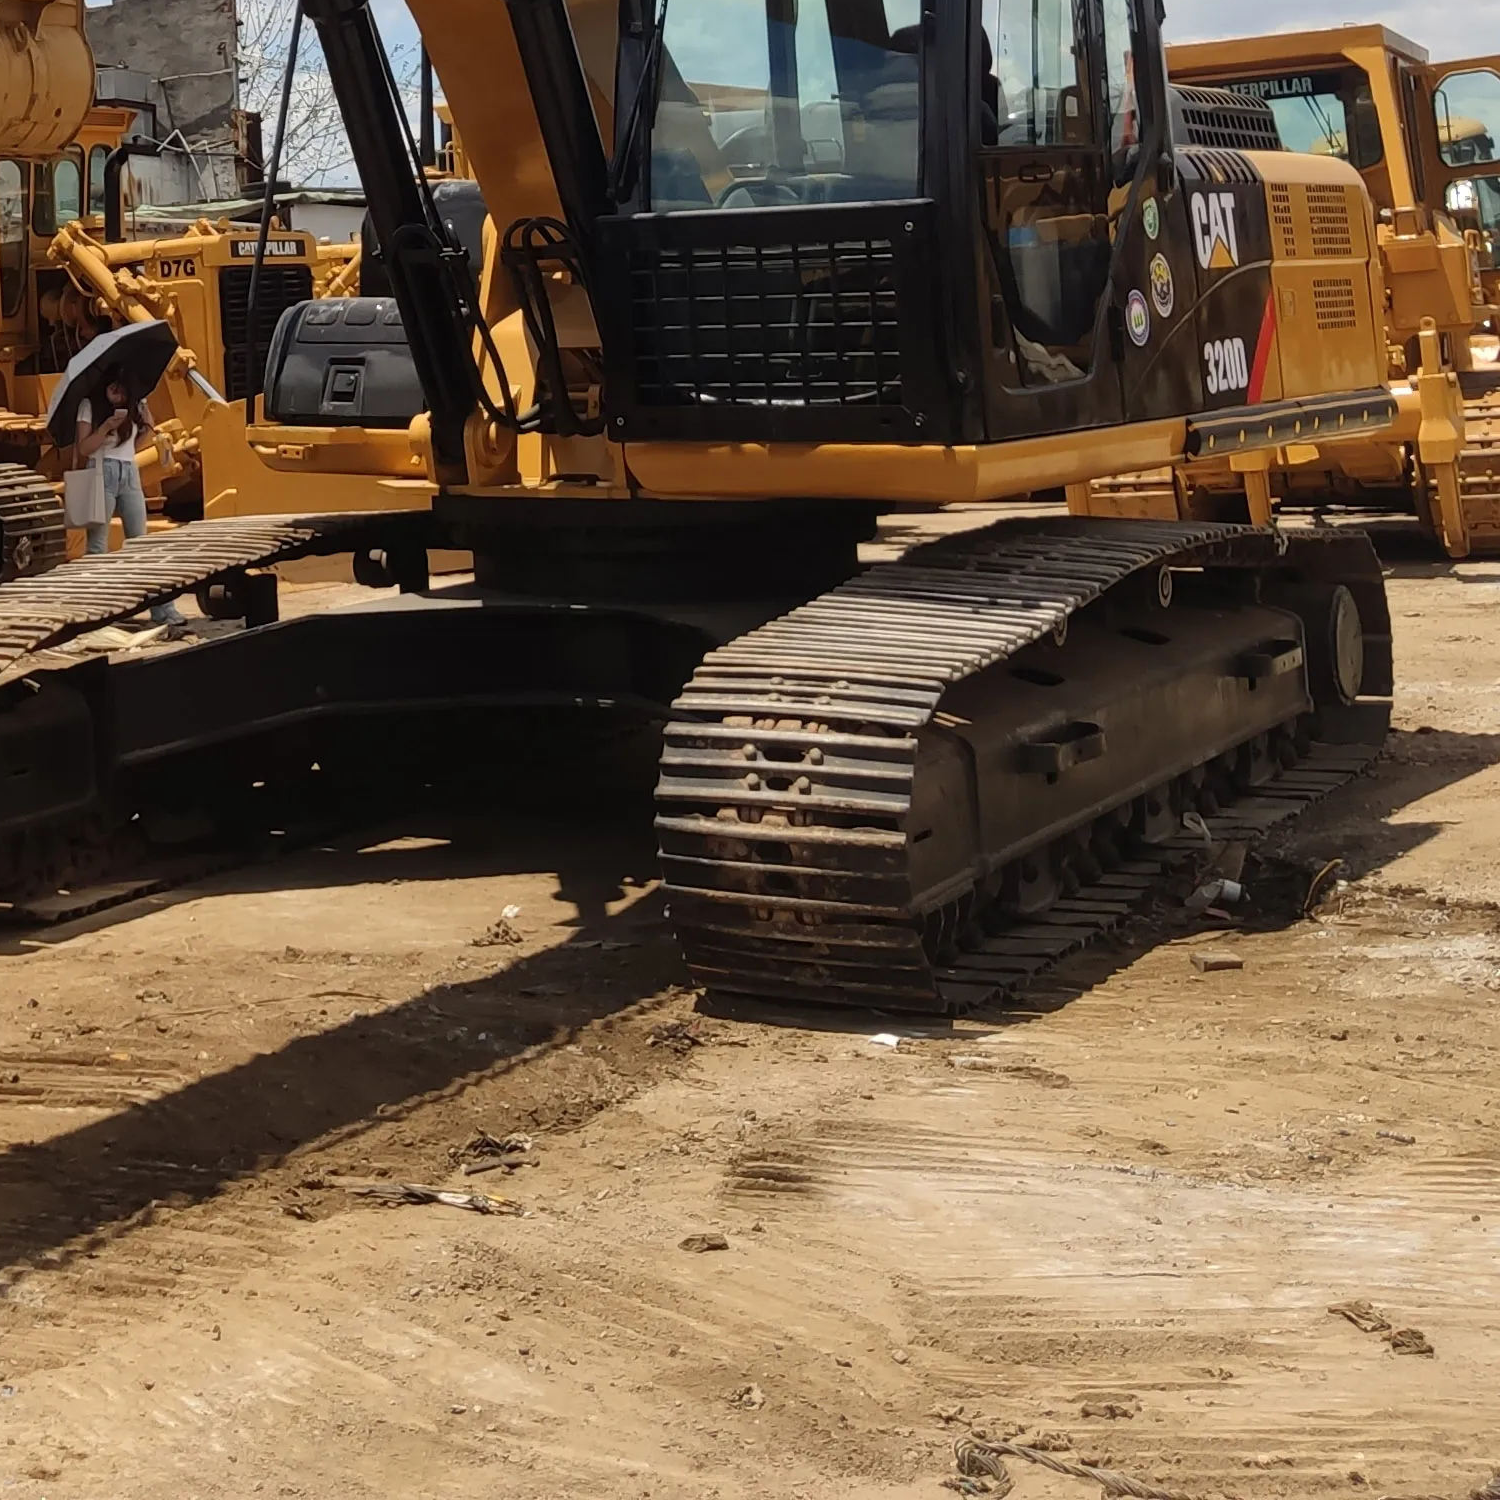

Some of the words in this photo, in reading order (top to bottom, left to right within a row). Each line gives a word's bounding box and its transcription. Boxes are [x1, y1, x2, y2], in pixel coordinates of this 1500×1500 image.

[1222, 76, 1313, 98] TERPILLAR
[1191, 191, 1240, 270] CAT
[238, 241, 297, 256] CATPILLAR
[160, 258, 196, 278] D7G
[1203, 337, 1249, 395] 320D
